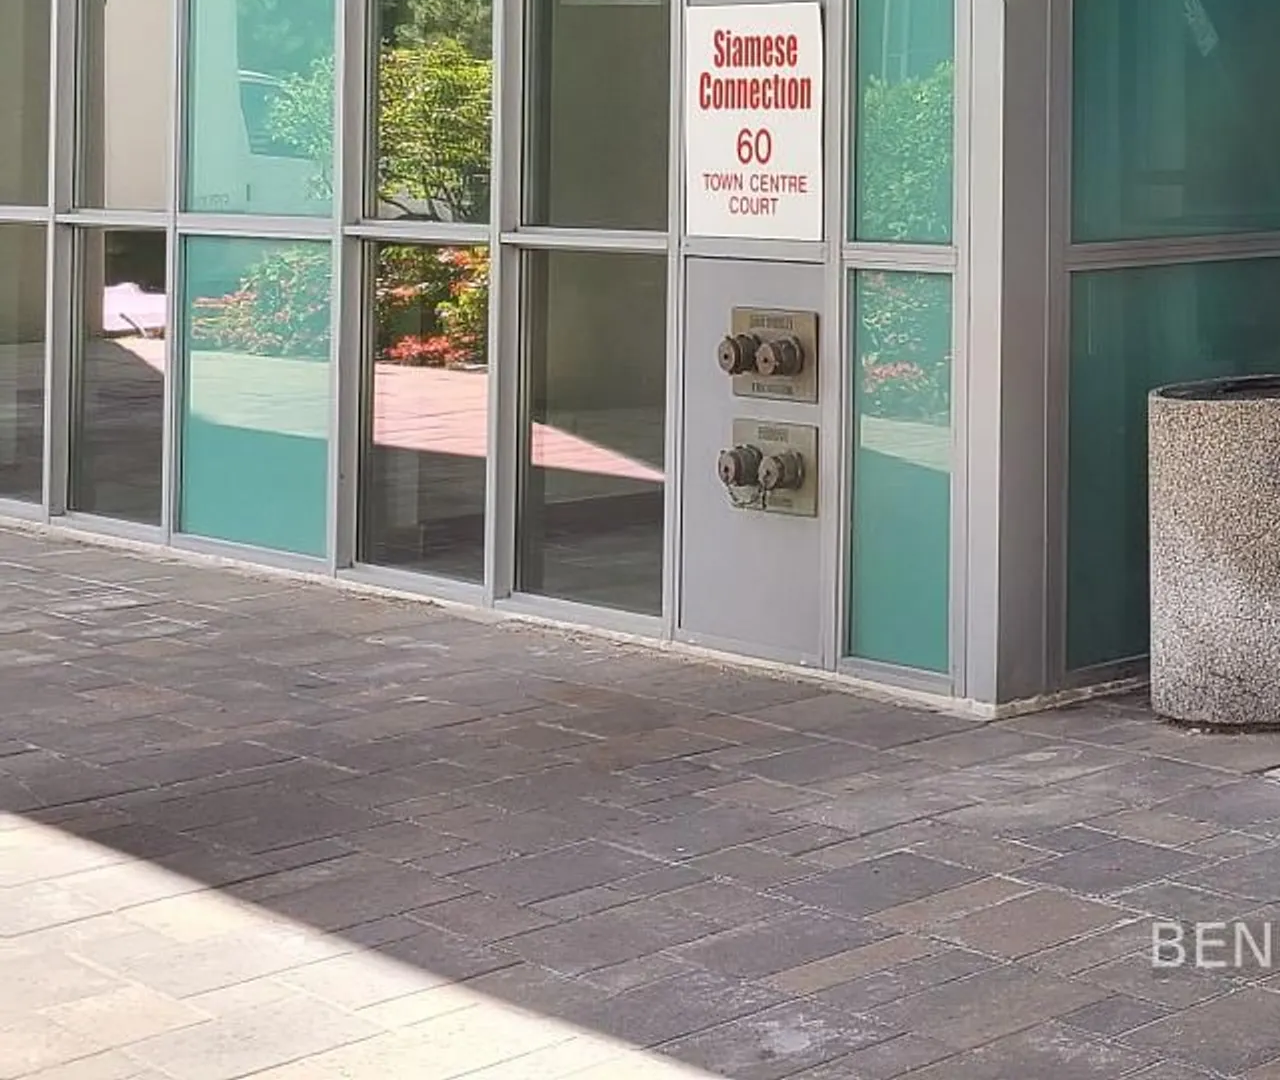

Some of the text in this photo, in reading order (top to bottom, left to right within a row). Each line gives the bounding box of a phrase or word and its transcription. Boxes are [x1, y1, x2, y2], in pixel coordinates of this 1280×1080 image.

[713, 30, 798, 68] Siamese
[699, 72, 812, 110] Connection
[737, 128, 772, 165] 60
[703, 174, 808, 193] TOWN CENTRE
[728, 196, 779, 215] COURT
